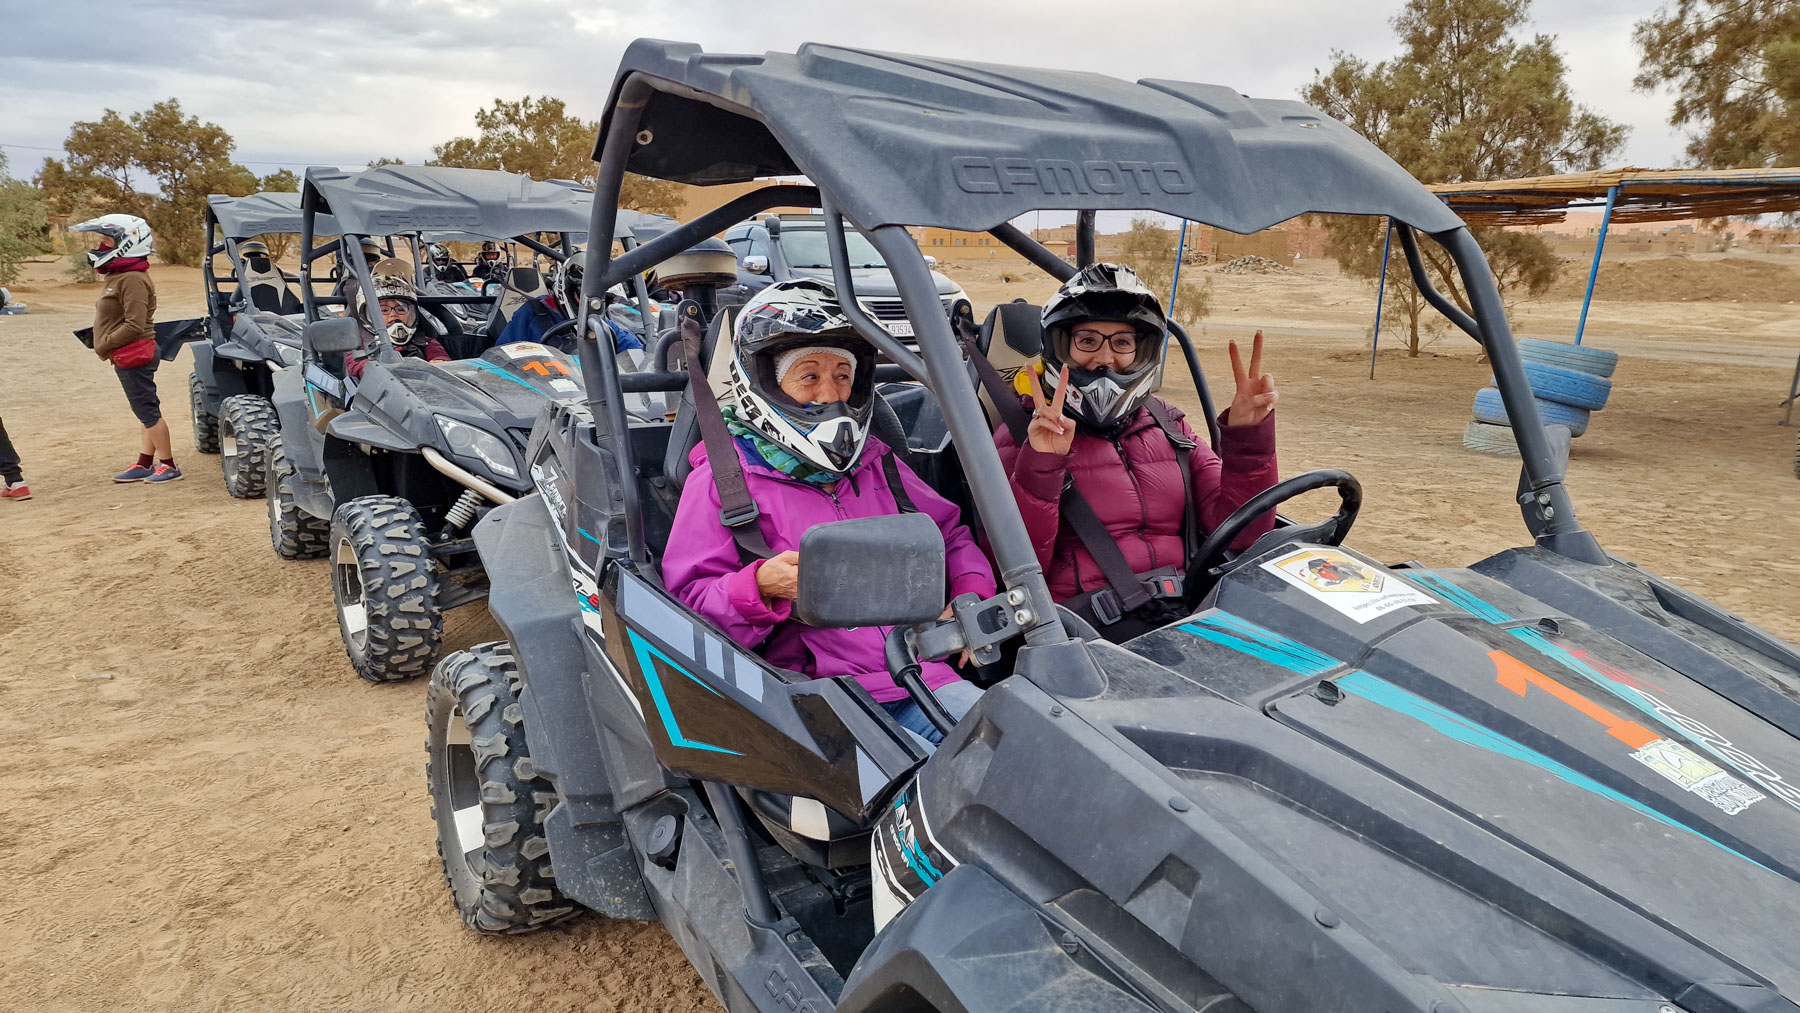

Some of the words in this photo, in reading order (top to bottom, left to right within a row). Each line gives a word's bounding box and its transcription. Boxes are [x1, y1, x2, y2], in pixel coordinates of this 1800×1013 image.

[952, 155, 1195, 196] CFMOTO
[376, 213, 482, 227] CFMOTO
[522, 360, 571, 376] 11
[1487, 650, 1661, 750] 1
